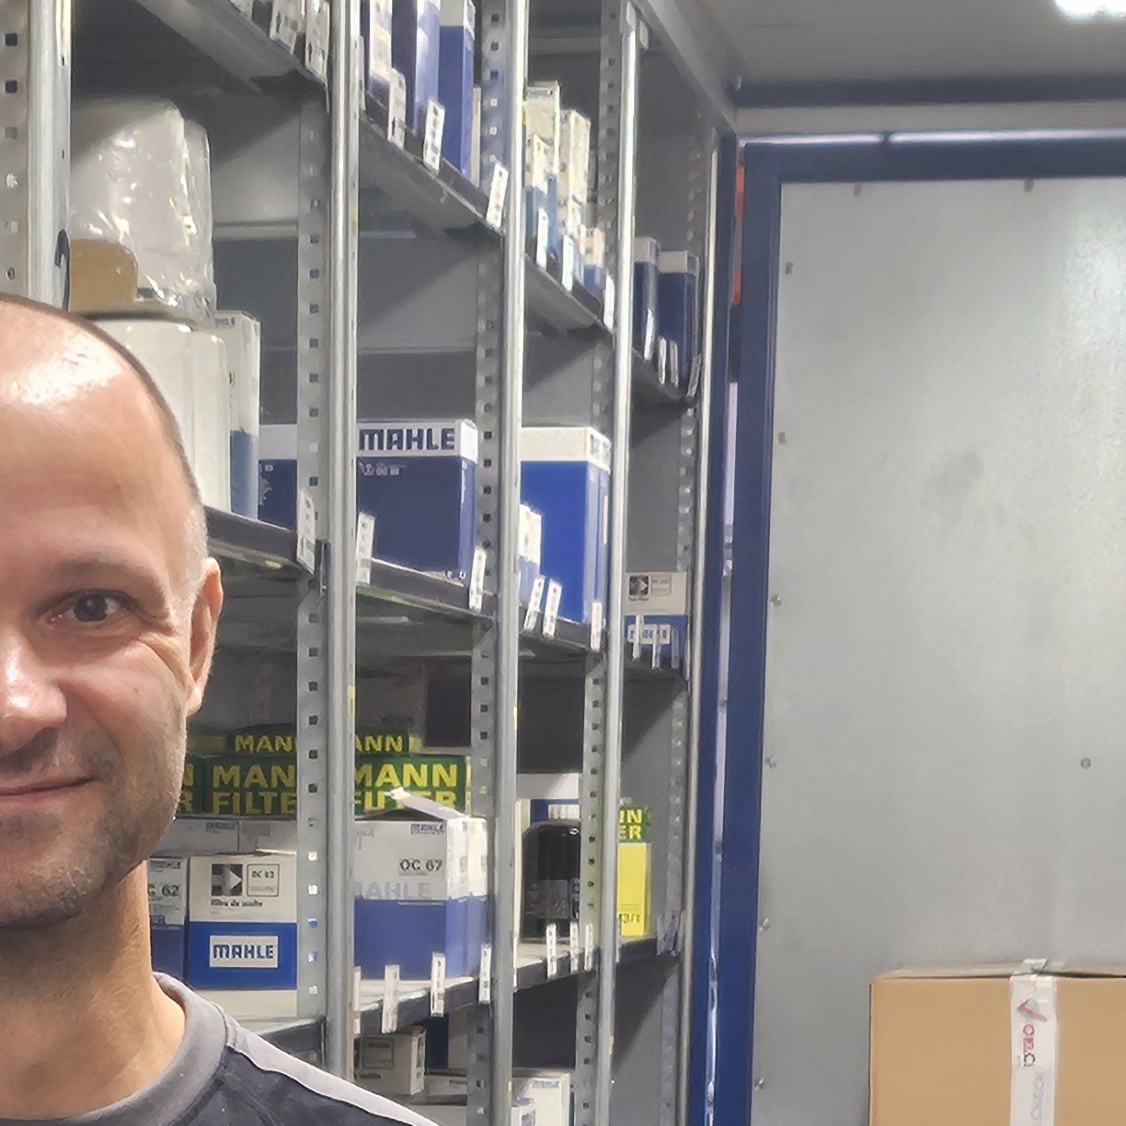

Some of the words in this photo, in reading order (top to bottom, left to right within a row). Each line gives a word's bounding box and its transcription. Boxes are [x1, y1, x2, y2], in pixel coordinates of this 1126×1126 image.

[358, 427, 457, 451] MAHLE
[235, 735, 296, 753] MAN
[354, 734, 403, 752] ANN
[212, 764, 296, 789] MAN
[212, 791, 296, 815] FILTE
[399, 859, 421, 871] OC
[425, 859, 443, 872] 67
[161, 884, 180, 897] 62
[212, 944, 274, 959] MAHLE
